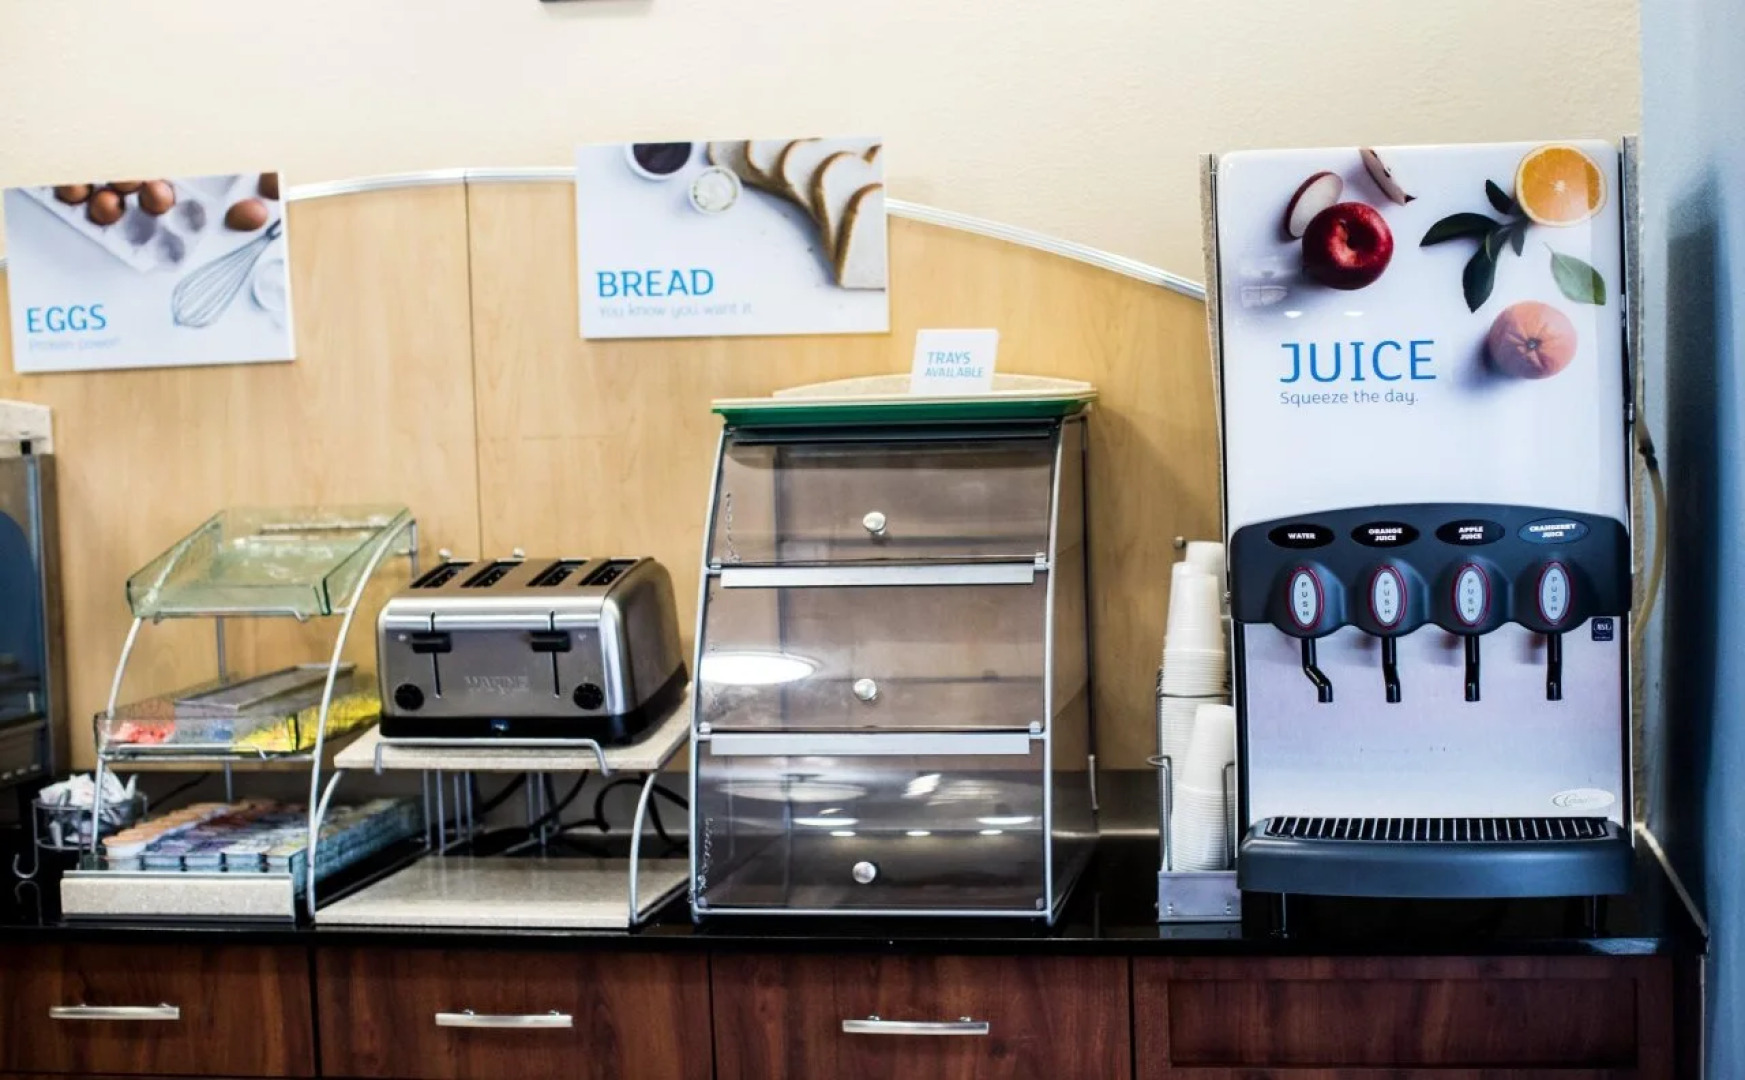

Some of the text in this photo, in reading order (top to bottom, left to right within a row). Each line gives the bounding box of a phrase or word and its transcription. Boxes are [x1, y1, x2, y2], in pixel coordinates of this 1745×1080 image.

[597, 269, 714, 297] BREAD
[26, 304, 107, 333] EGGS
[600, 305, 624, 318] You
[629, 303, 666, 316] know
[671, 306, 698, 319] you
[704, 303, 737, 315] want
[927, 351, 971, 364] TRAYS
[1280, 340, 1437, 383] JUICE
[925, 366, 984, 378] AVAILABLE
[1280, 388, 1418, 407] Squeeze the day.
[1288, 532, 1315, 540] WATER
[1301, 582, 1310, 616] PUSH
[1383, 581, 1391, 615] PUSH
[1467, 578, 1475, 614] PUSH
[1550, 576, 1558, 612] PUSH
